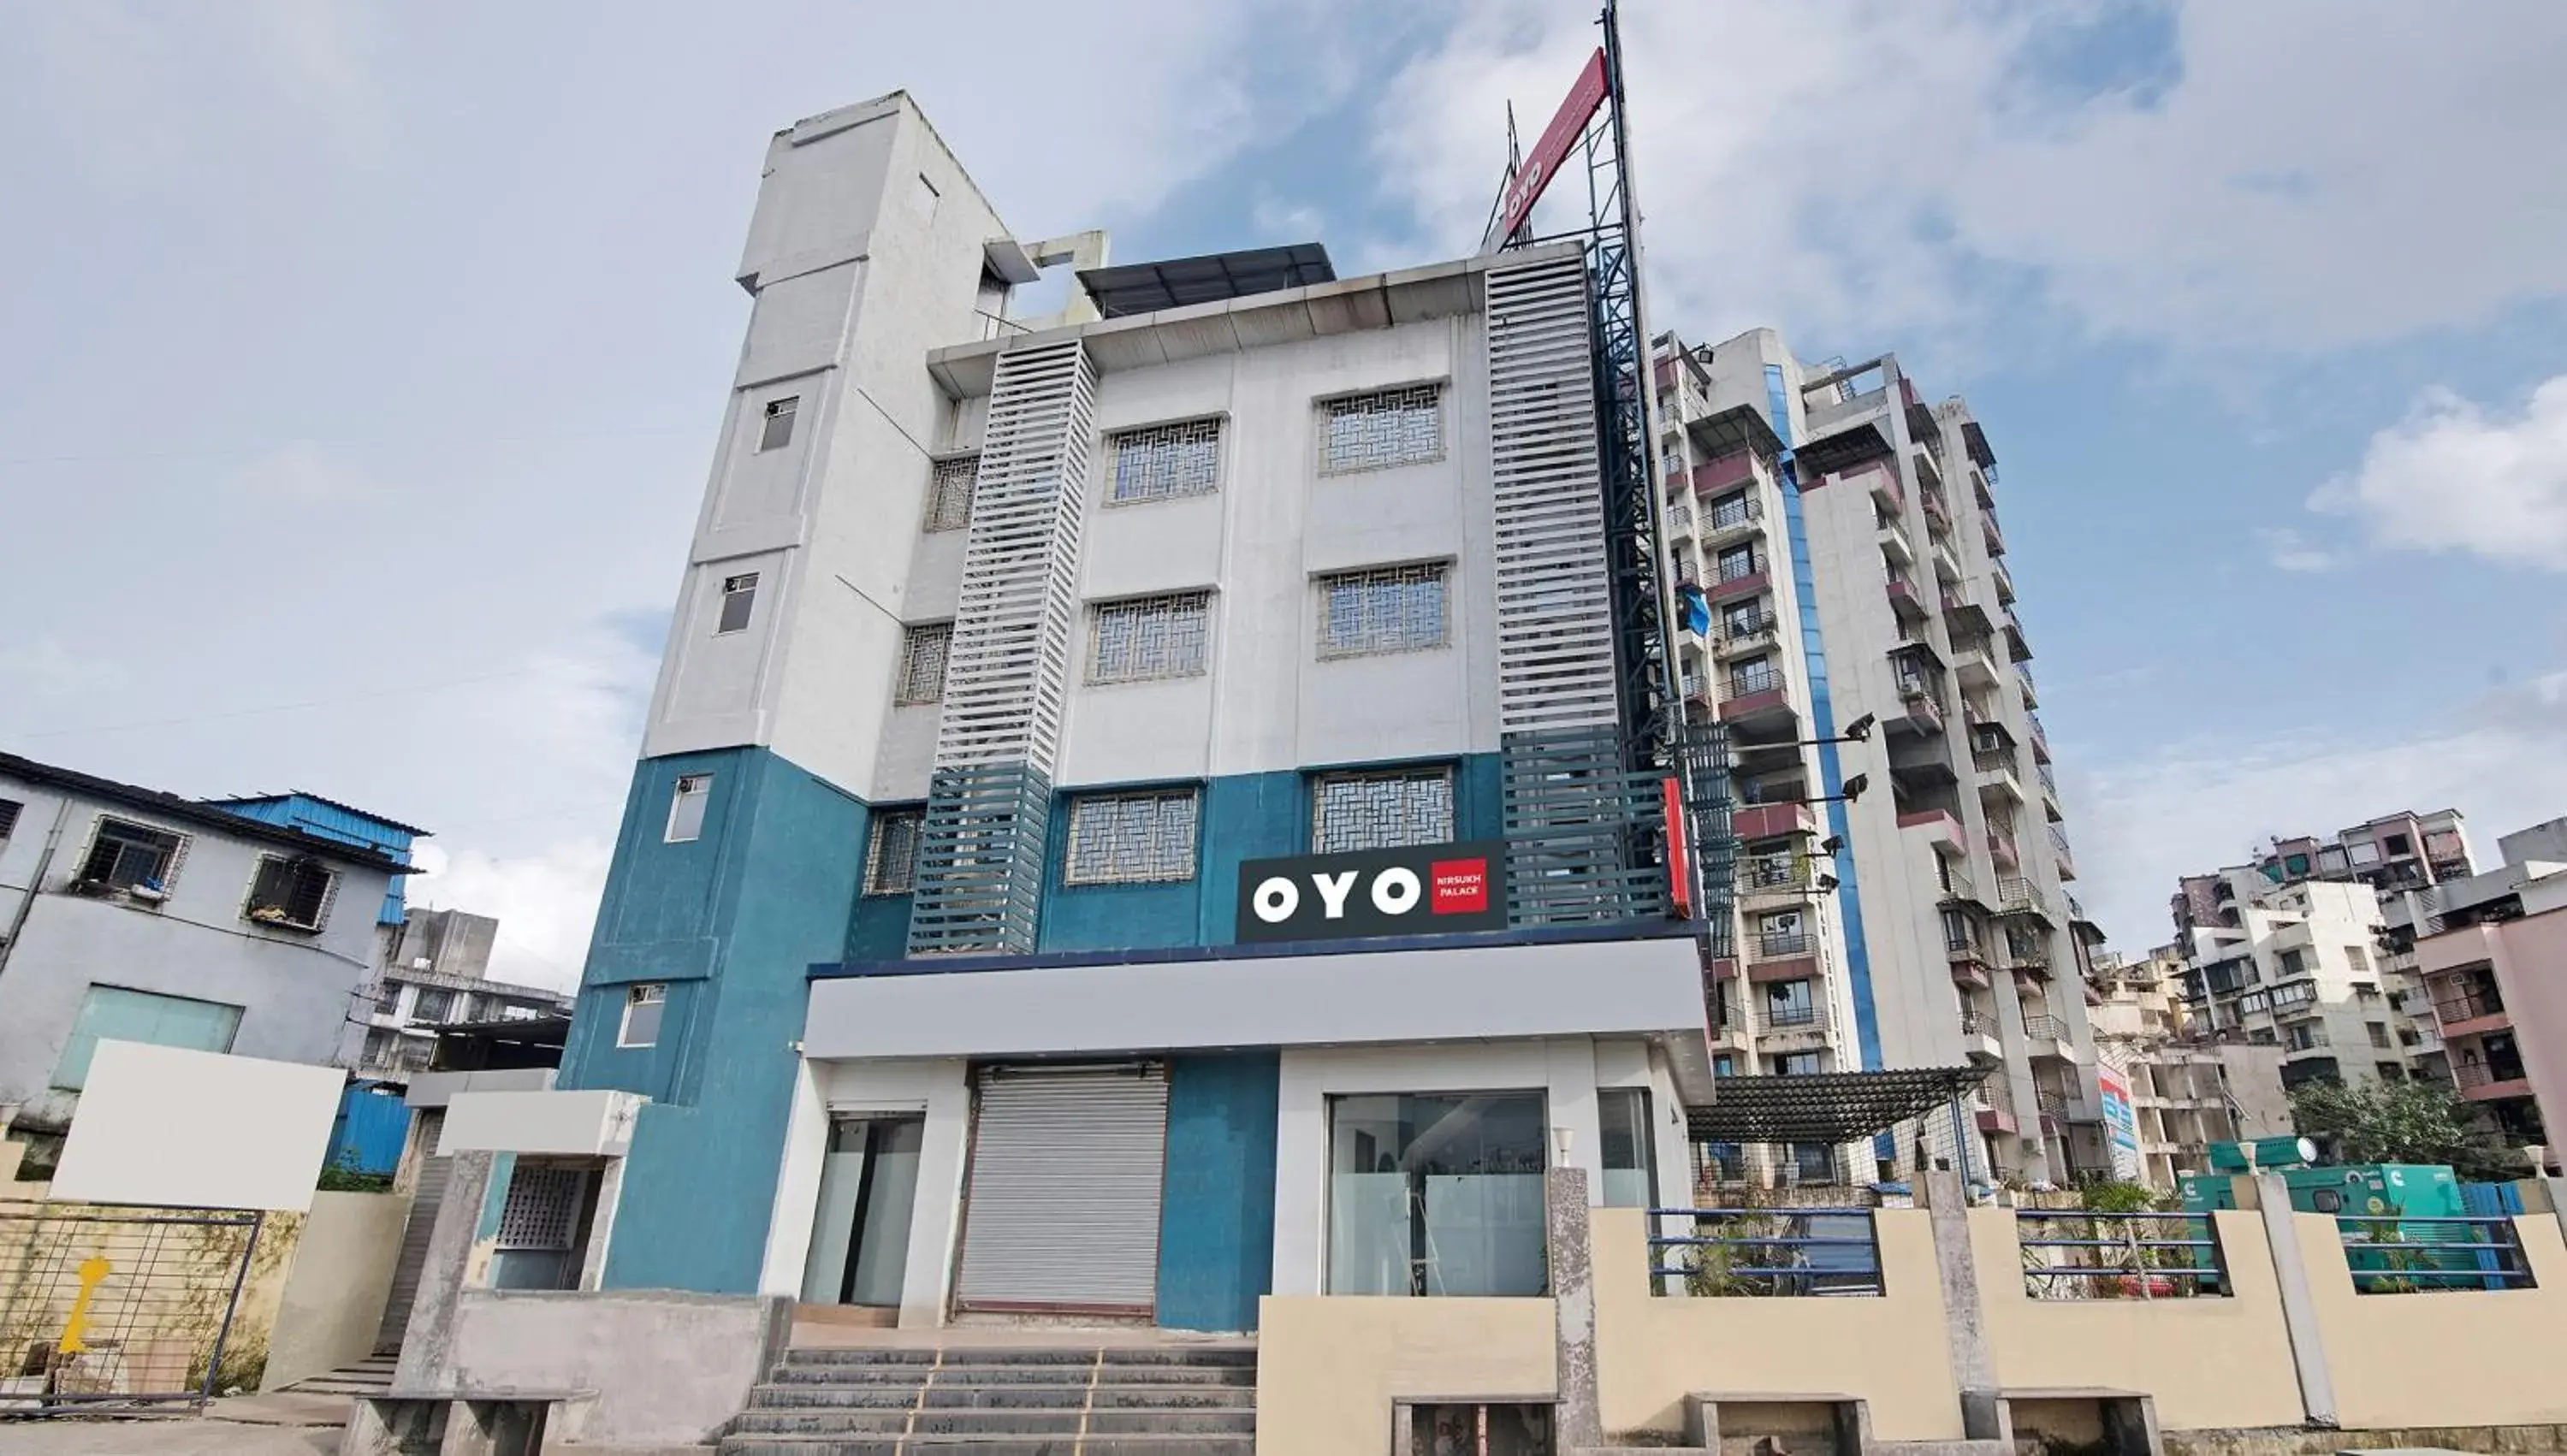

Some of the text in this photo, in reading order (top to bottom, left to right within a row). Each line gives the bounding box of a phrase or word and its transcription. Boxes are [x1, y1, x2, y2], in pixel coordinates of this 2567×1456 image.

[1509, 162, 1543, 219] OYO
[1253, 867, 1421, 923] OYO
[1437, 873, 1481, 885] NIRSUKH
[1440, 886, 1479, 897] PALACE
